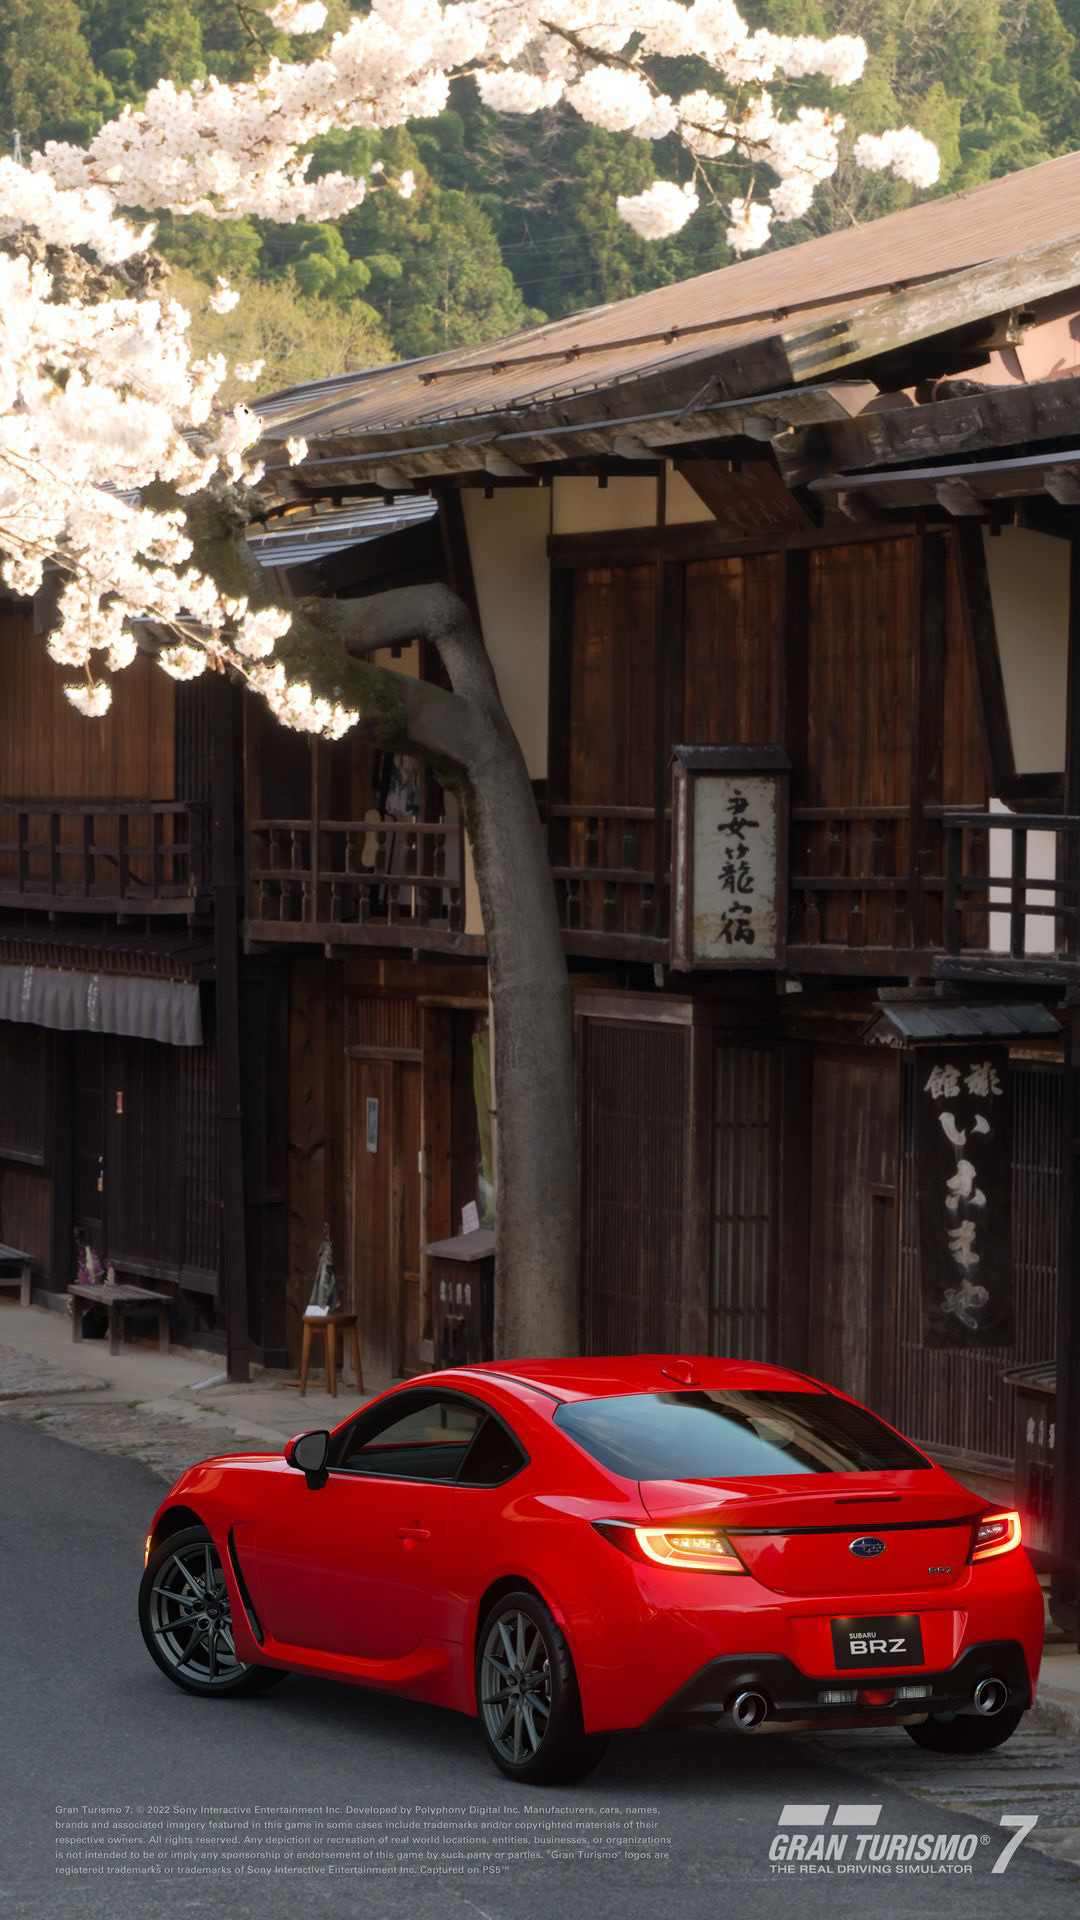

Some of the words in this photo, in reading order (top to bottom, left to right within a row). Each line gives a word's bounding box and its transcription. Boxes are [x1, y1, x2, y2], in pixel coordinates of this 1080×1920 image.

[715, 788, 760, 945] 妻籠宿
[849, 1638, 907, 1655] BRZ
